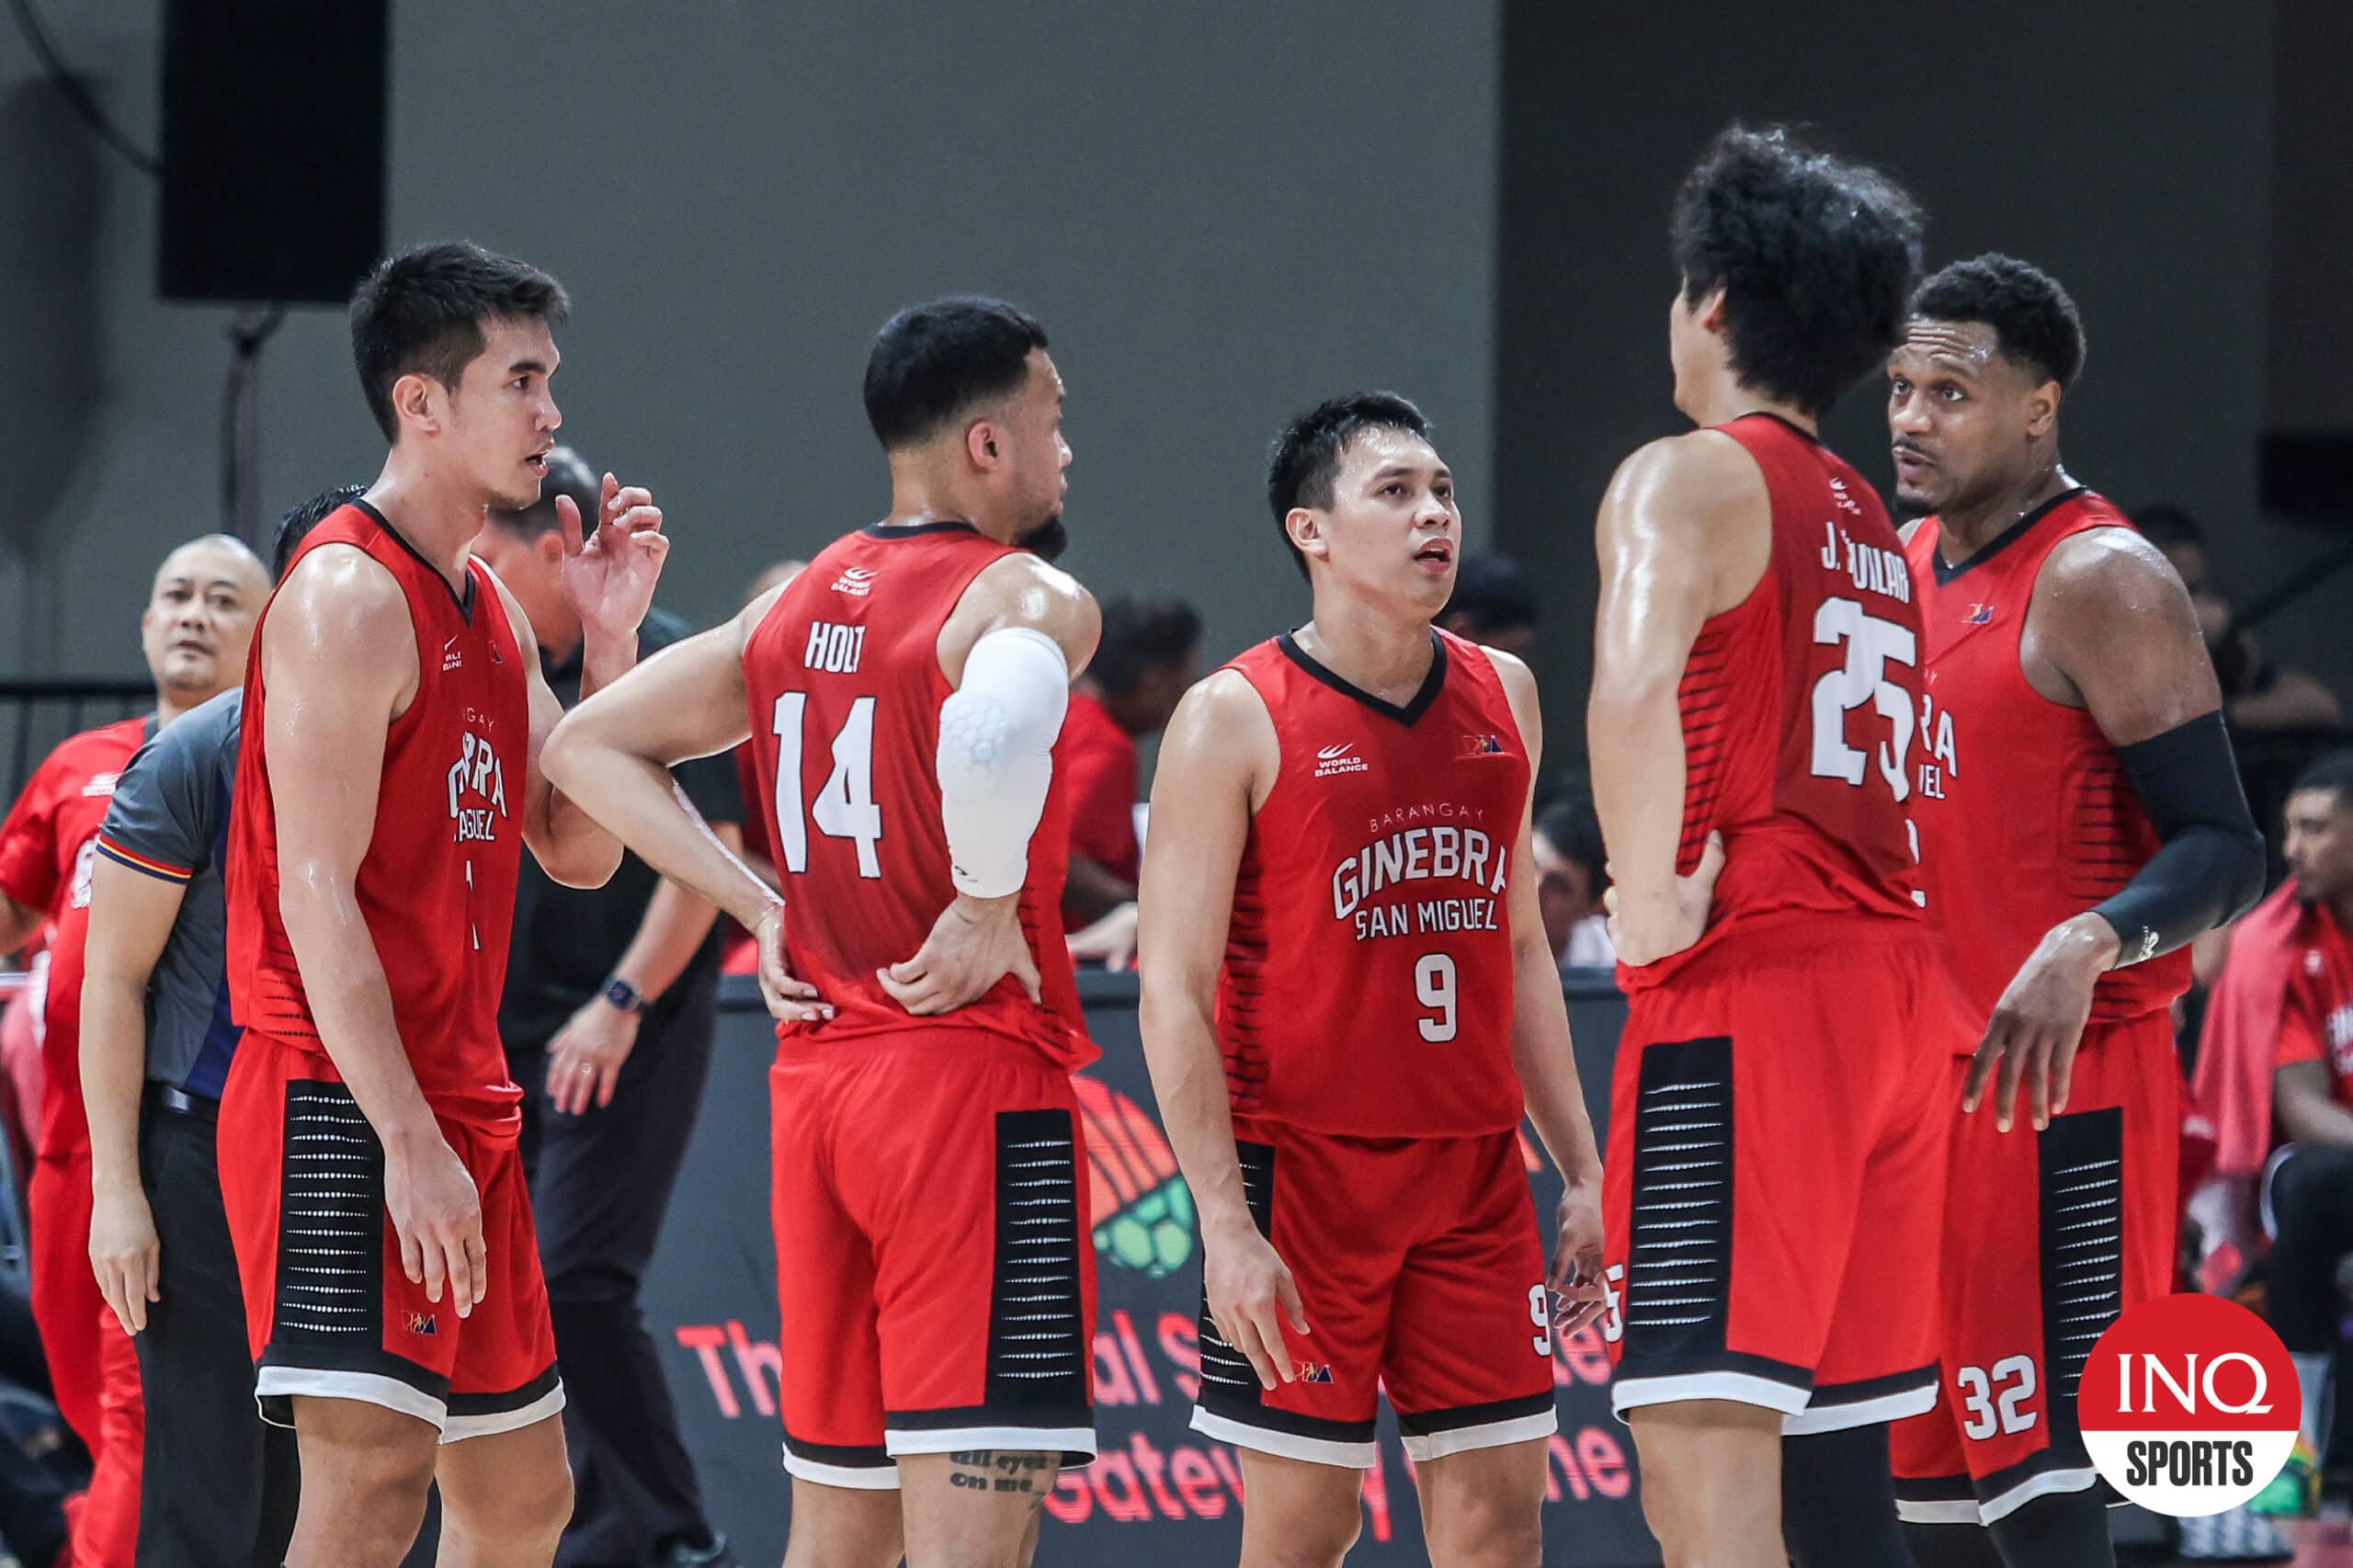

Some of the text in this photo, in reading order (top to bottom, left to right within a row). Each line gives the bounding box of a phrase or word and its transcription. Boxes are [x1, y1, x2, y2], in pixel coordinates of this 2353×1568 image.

[1821, 521, 1841, 570] J.
[804, 621, 866, 674] HOLT
[1811, 596, 1916, 803] 25
[772, 691, 882, 880] 14
[1314, 763, 1369, 778] BALANCE
[1319, 756, 1361, 768] WORLD
[1370, 802, 1483, 833] BARANGAY
[1333, 825, 1507, 920] GINEBRA
[1355, 898, 1498, 941] SAN MIGUEL
[1414, 952, 1457, 1043] 9
[1529, 1283, 1552, 1357] 9
[1957, 1353, 2038, 1440] 32
